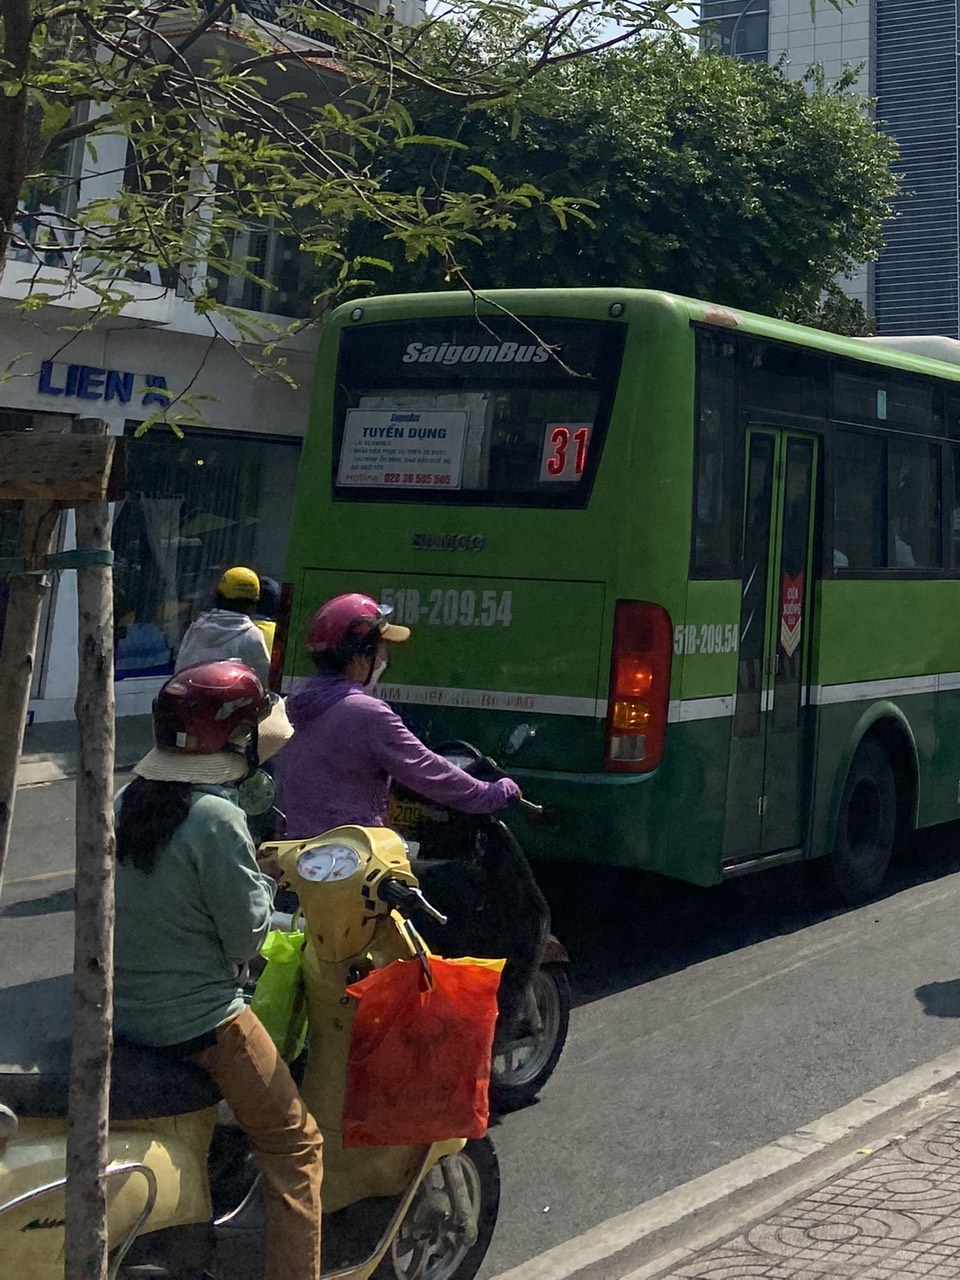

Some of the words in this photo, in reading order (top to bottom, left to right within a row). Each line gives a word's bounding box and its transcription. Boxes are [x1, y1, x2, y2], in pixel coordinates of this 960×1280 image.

[402, 341, 552, 366] SaigonBus
[408, 427, 447, 441] DỤNG
[546, 425, 590, 478] 31
[673, 623, 739, 655] 51B-209.54
